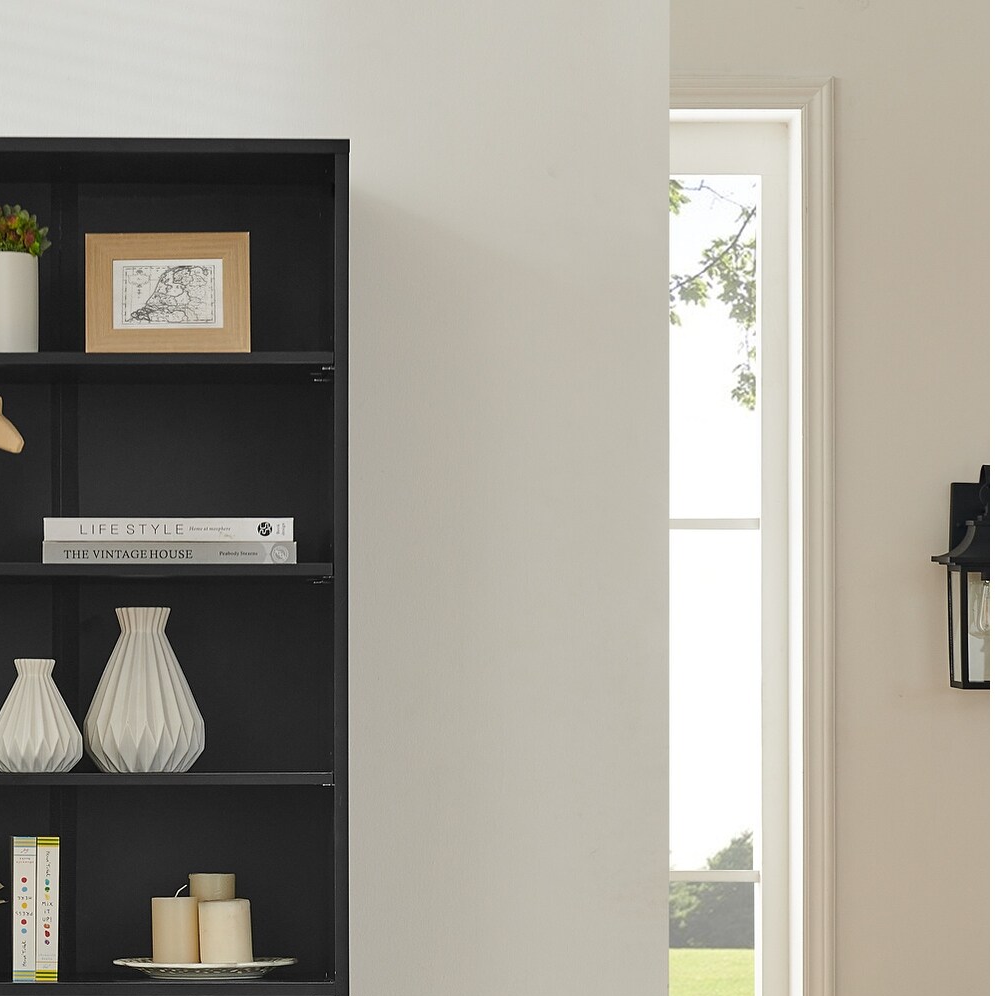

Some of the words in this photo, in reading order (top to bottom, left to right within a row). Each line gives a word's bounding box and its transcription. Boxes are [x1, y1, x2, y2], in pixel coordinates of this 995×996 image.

[79, 523, 119, 535] LIFE
[126, 523, 185, 535] STYLE
[63, 549, 90, 559] THE
[92, 549, 148, 559] VINTAGE
[150, 549, 193, 559] HOUSE
